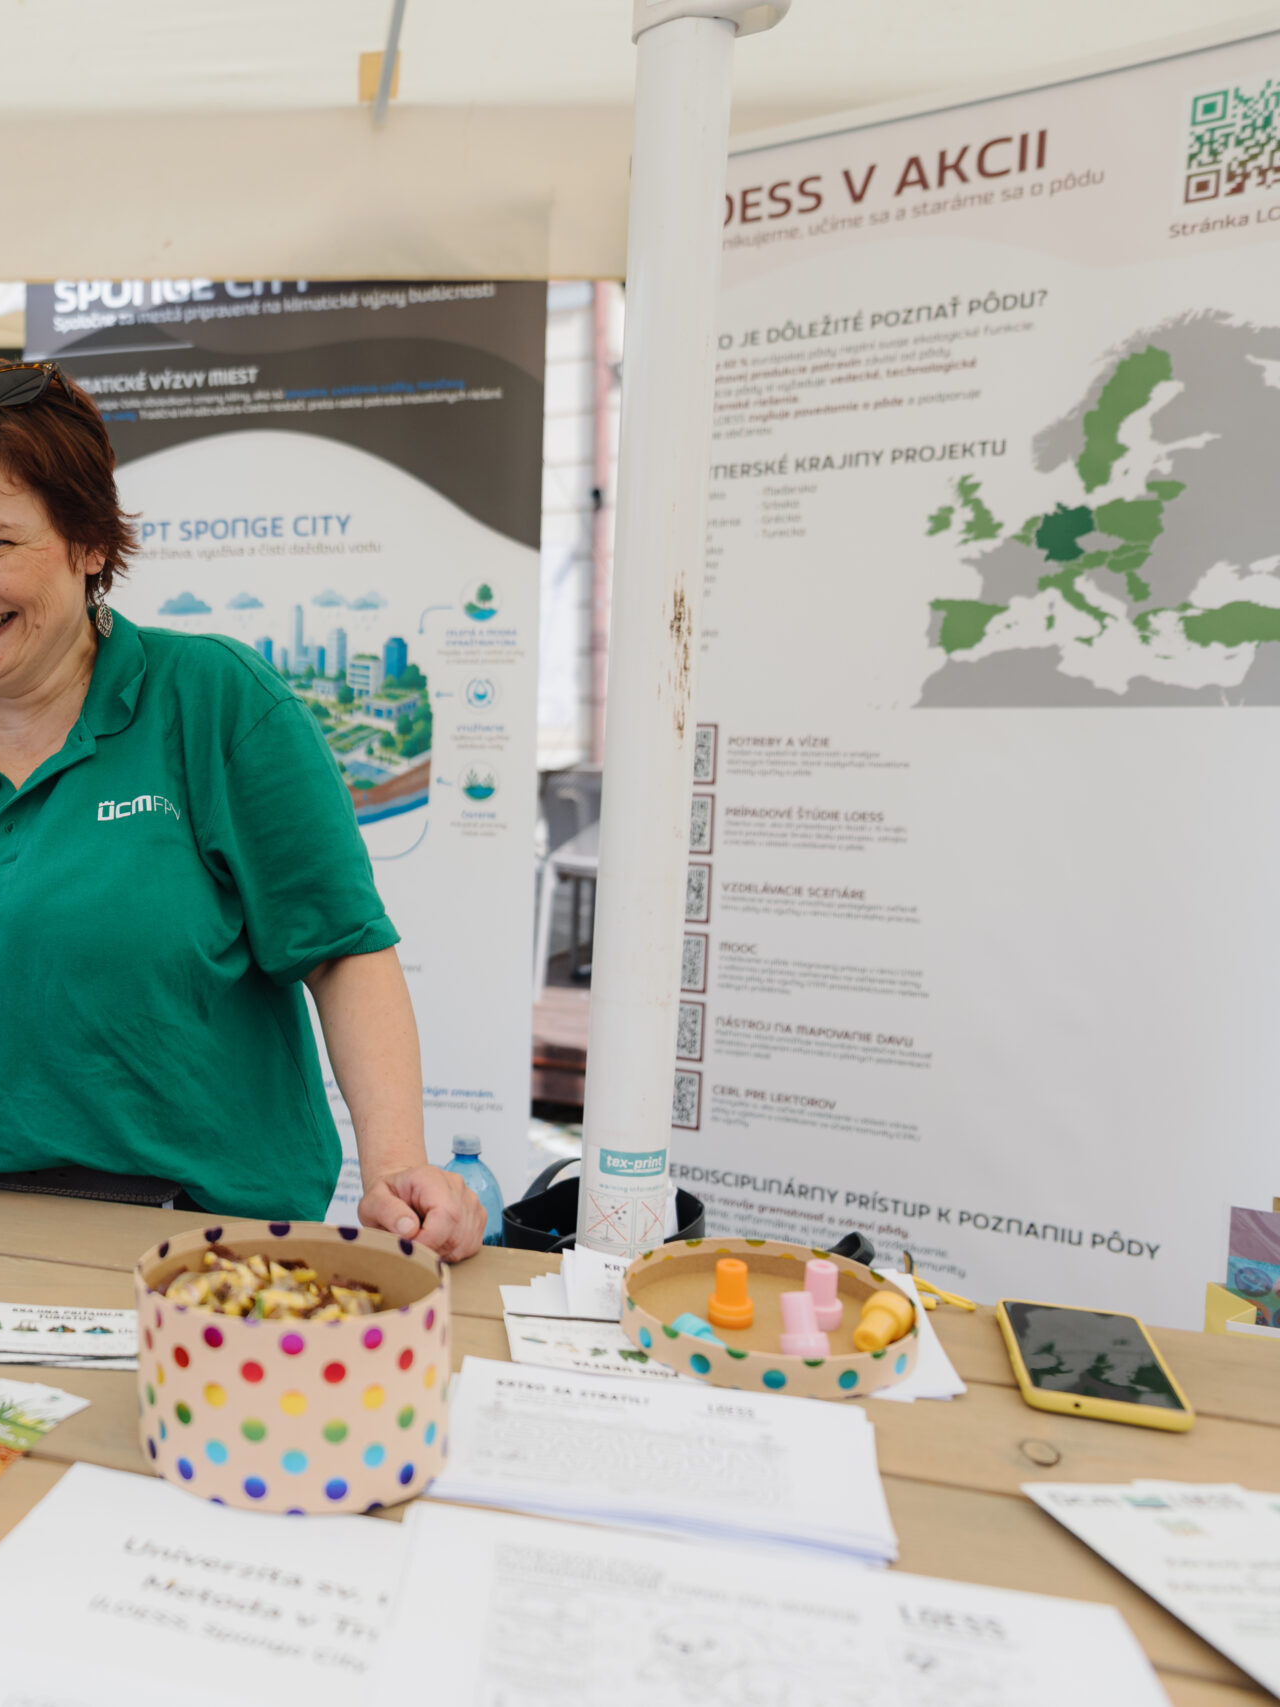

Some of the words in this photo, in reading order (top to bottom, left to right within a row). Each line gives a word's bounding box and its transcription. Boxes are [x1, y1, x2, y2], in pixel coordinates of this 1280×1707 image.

[843, 164, 877, 204] V
[894, 129, 1049, 197] AKCII
[869, 209, 890, 226] sa
[896, 207, 907, 221] a
[1000, 184, 1025, 203] sa
[1031, 184, 1044, 197] o
[1050, 167, 1105, 196] pôdu
[1168, 213, 1249, 239] Stránka
[740, 330, 762, 348] JE
[766, 308, 864, 345] DÔLEŽITÉ
[870, 296, 962, 329] POZNAŤ
[968, 289, 1048, 316] PÔDU?
[709, 454, 789, 480] NERSKÉ
[794, 449, 884, 474] KRAJINY
[891, 439, 1008, 465] PROJEKTU
[179, 516, 285, 542] SPONGE
[292, 513, 352, 537] CITY
[606, 1154, 663, 1171] tex-print
[844, 1189, 932, 1220] PRÍSTUP
[937, 1206, 952, 1224] K
[958, 1210, 1083, 1247] POZNANIU
[1090, 1230, 1161, 1260] PÔDY
